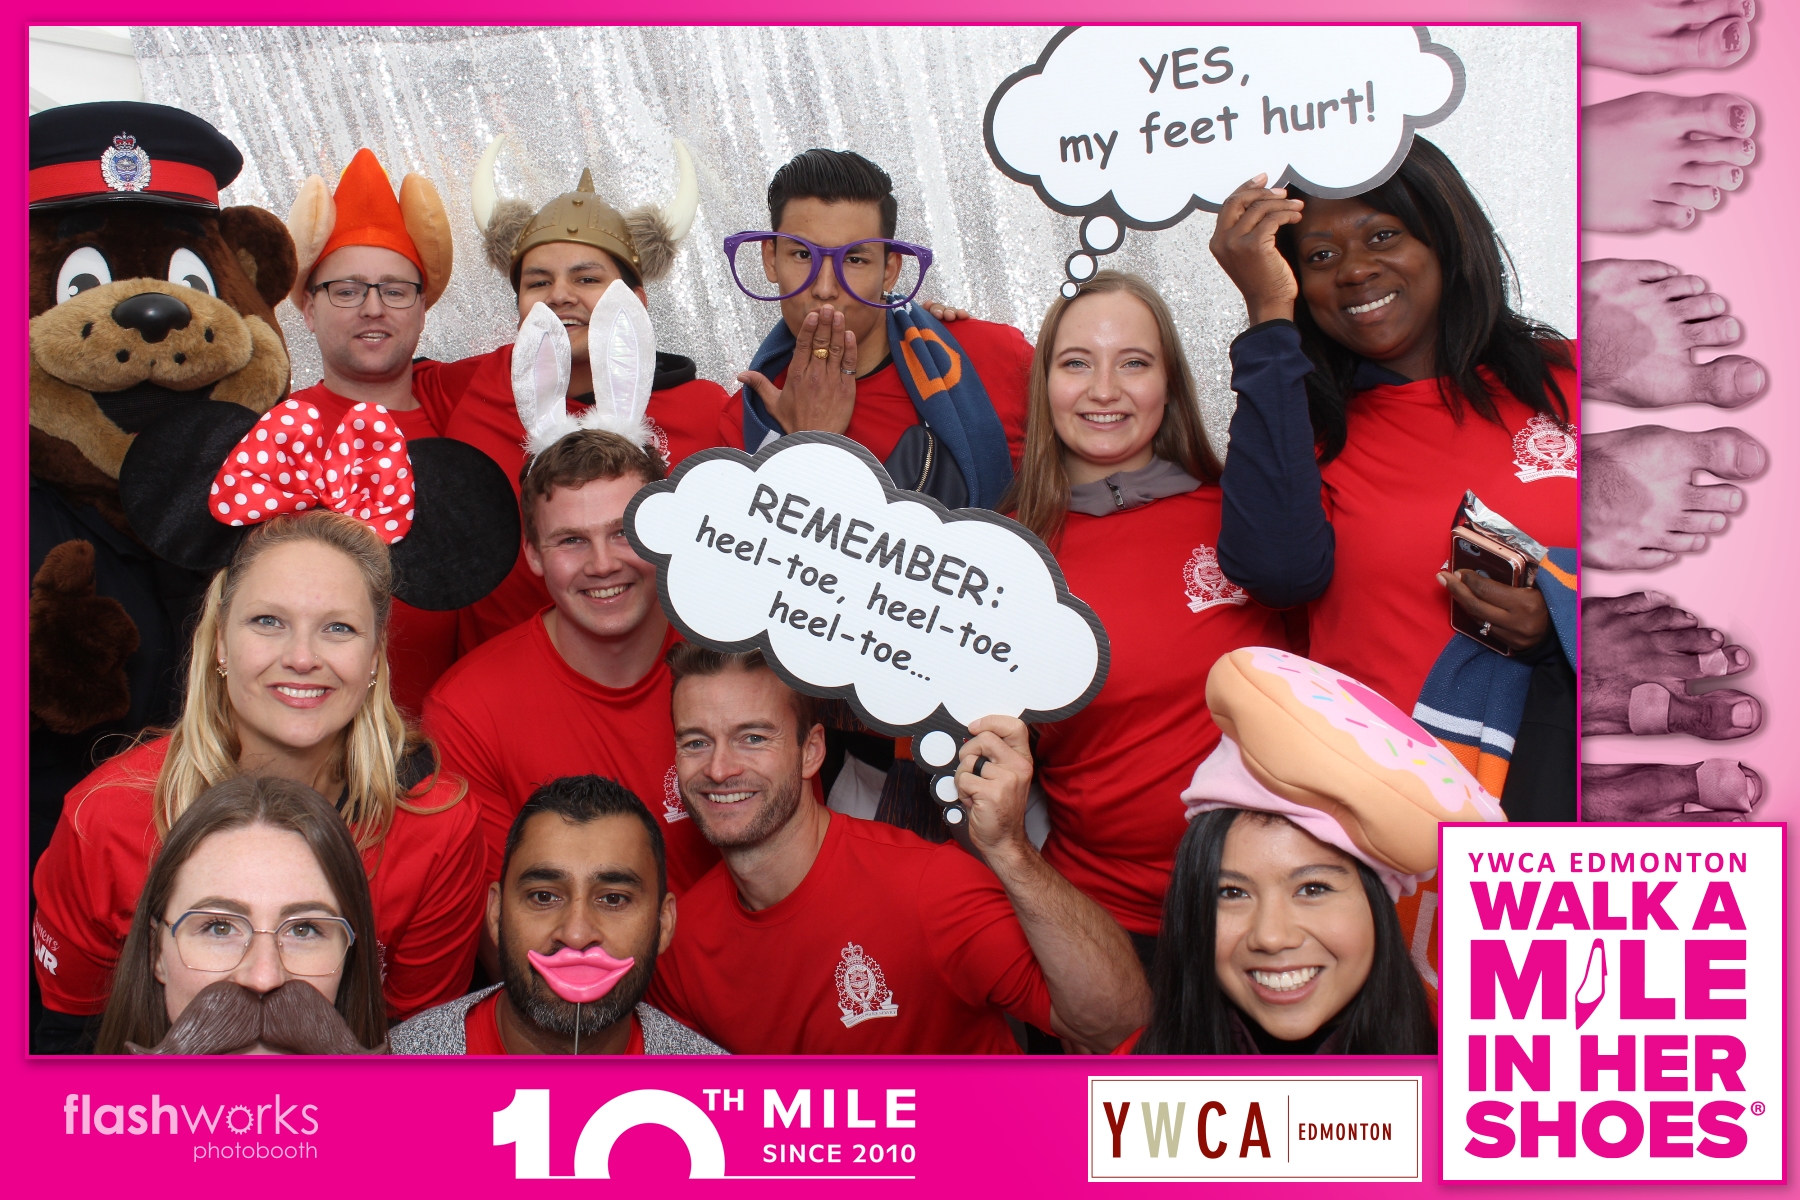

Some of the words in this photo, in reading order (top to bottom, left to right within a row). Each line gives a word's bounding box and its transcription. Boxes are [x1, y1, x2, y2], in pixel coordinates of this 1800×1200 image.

[1138, 46, 1250, 94] YES,
[1059, 130, 1119, 170] my
[1139, 106, 1239, 154] feet
[1262, 80, 1375, 135] hurt!
[695, 514, 846, 605] heel-toe,
[866, 581, 1020, 673] heel-toe,
[747, 483, 1004, 609] REMEMBER:
